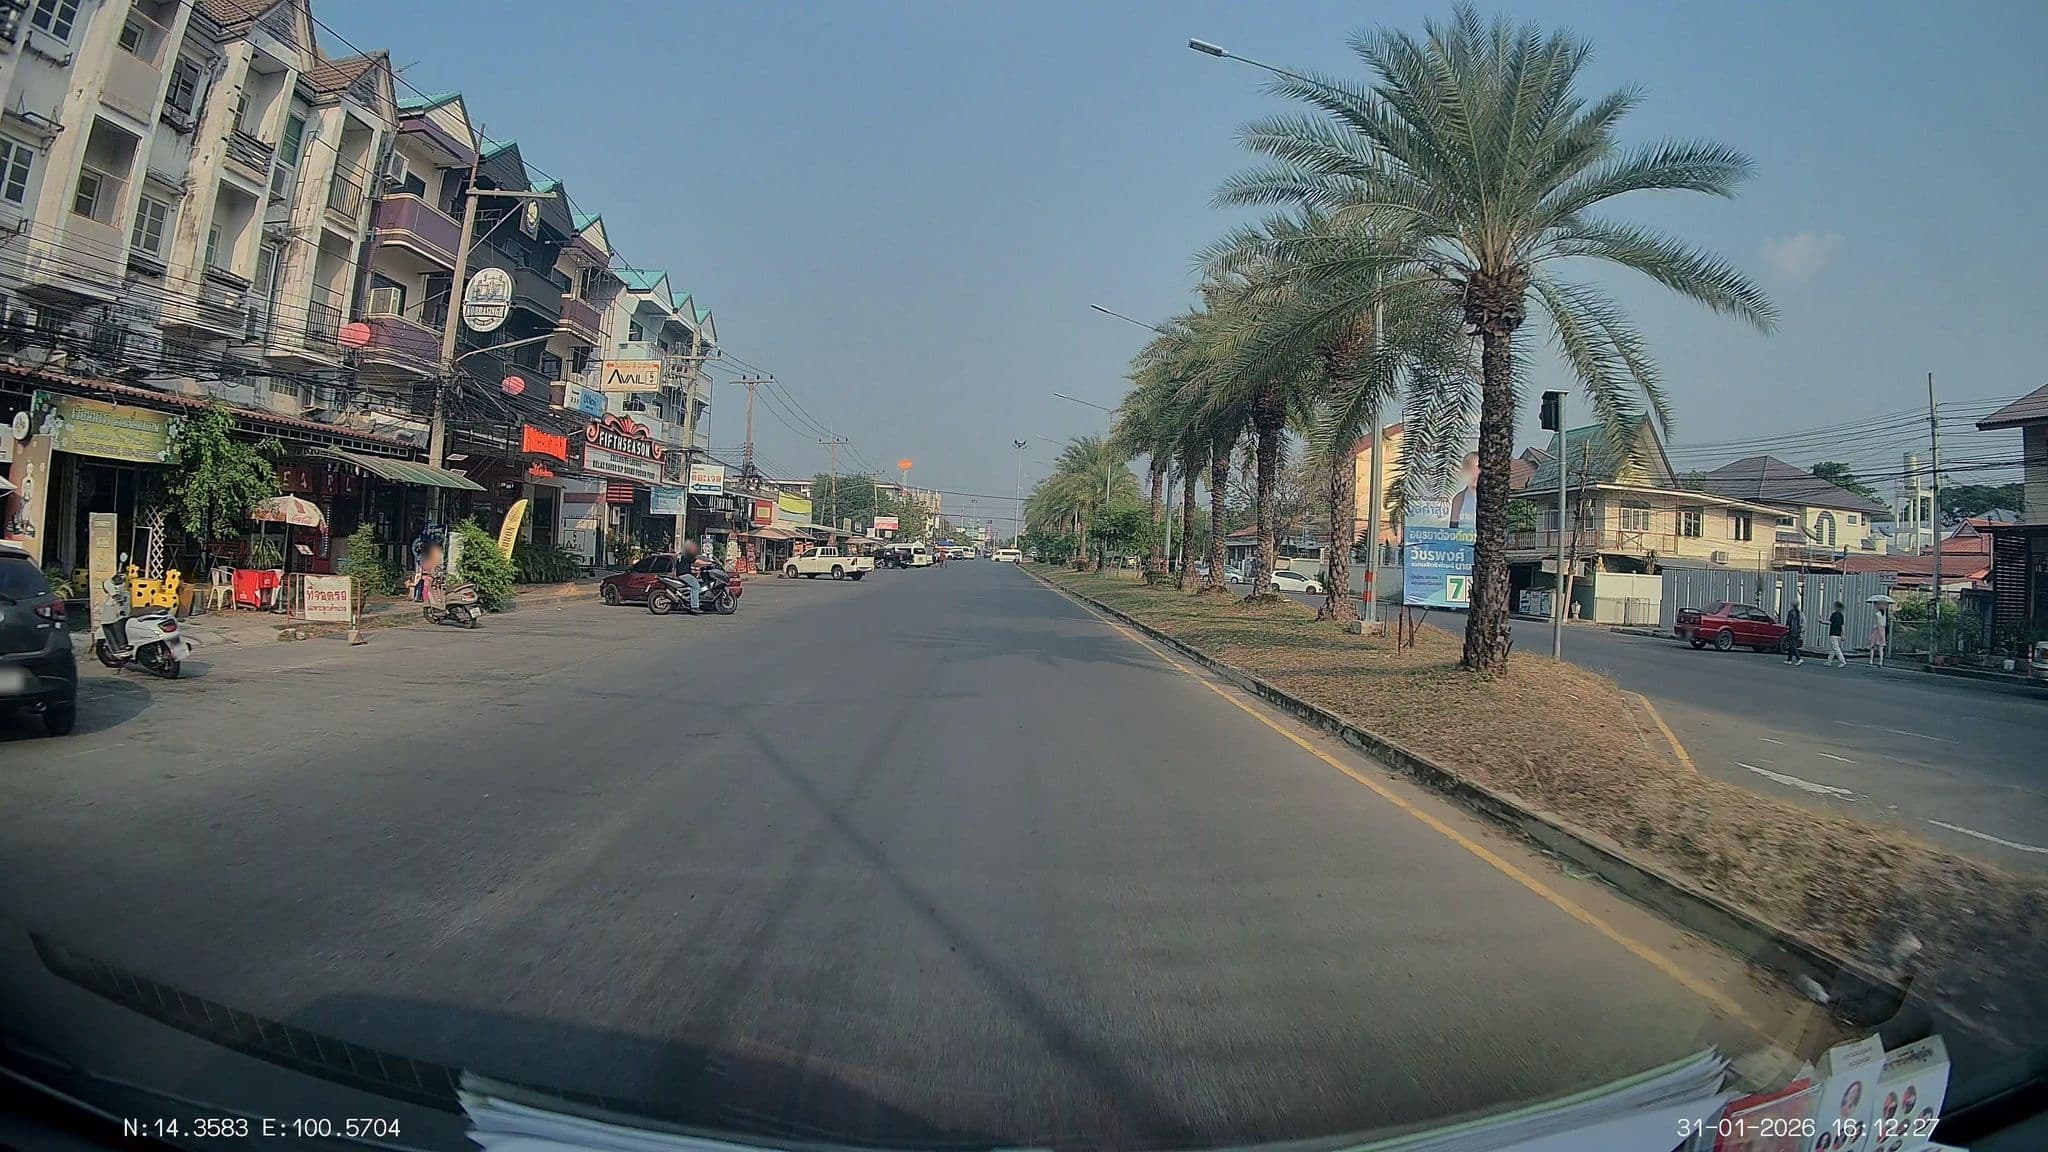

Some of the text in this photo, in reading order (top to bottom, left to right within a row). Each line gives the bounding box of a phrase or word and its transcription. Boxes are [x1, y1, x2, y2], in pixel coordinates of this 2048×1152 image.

[607, 369, 644, 384] AVAIL
[599, 431, 650, 457] FIFTHSEASON
[1411, 547, 1465, 562] วัชรพงศ์
[306, 586, 347, 601] ที่จอดรถ
[1449, 578, 1464, 600] 7
